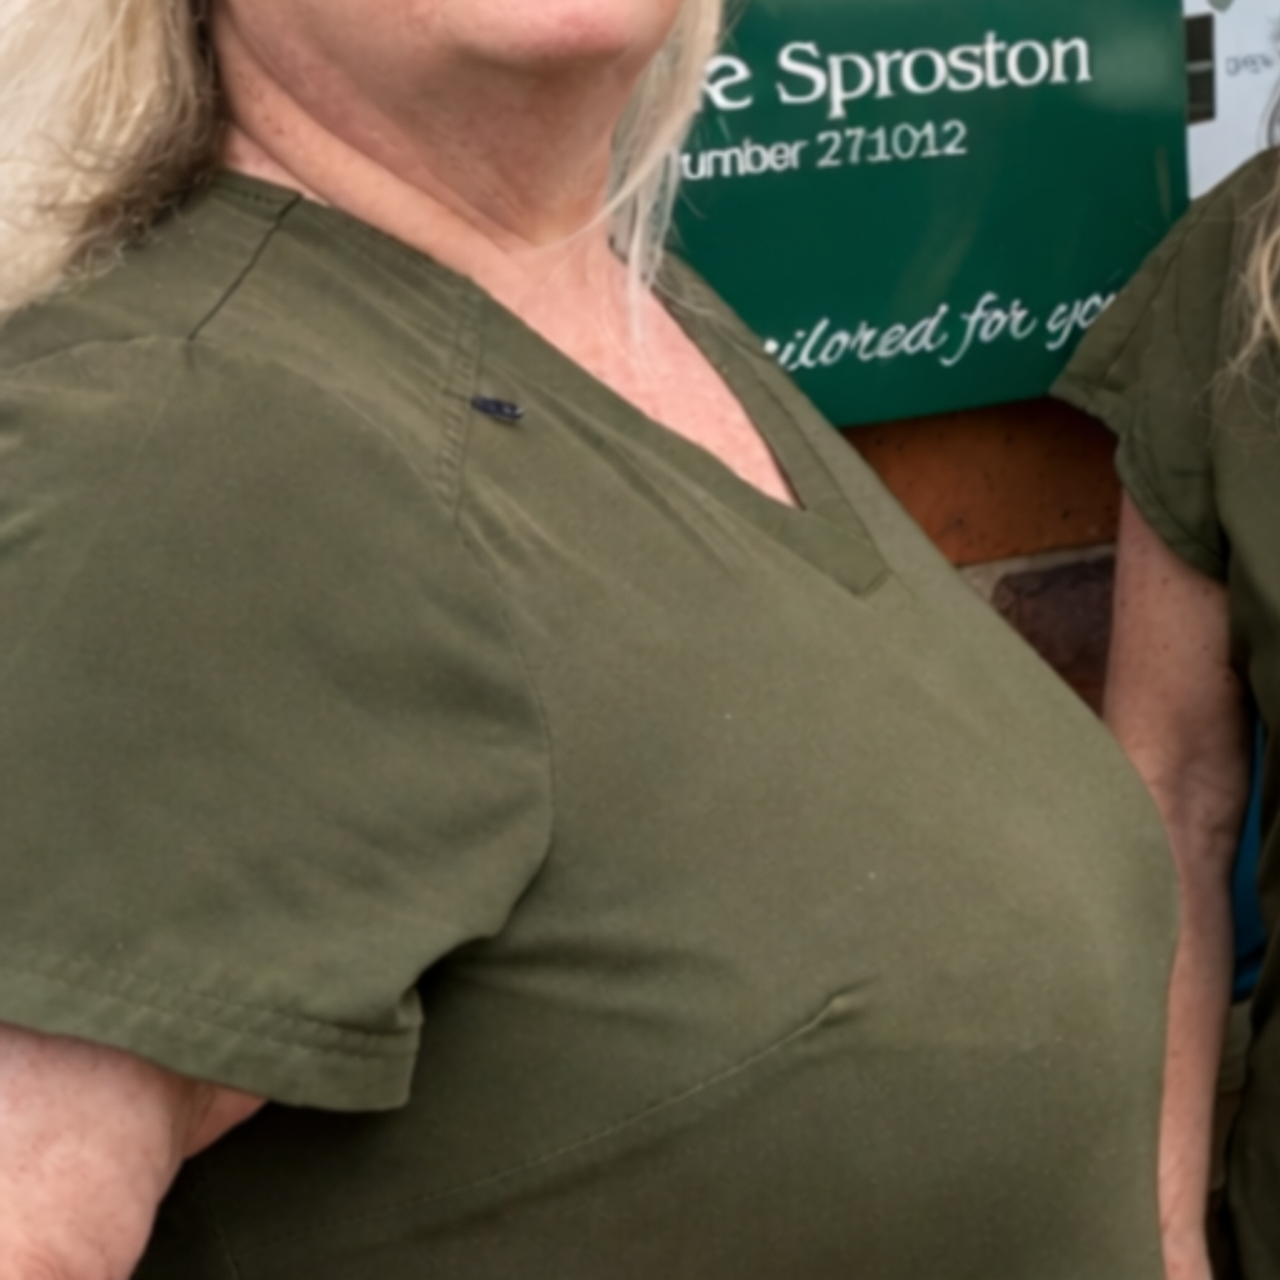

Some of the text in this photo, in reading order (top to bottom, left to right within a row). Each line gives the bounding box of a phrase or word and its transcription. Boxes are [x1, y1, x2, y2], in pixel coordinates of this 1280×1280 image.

[776, 30, 1093, 120] Sproston
[680, 119, 968, 181] umber 271012
[764, 302, 950, 372] ilored
[940, 291, 1037, 367] for
